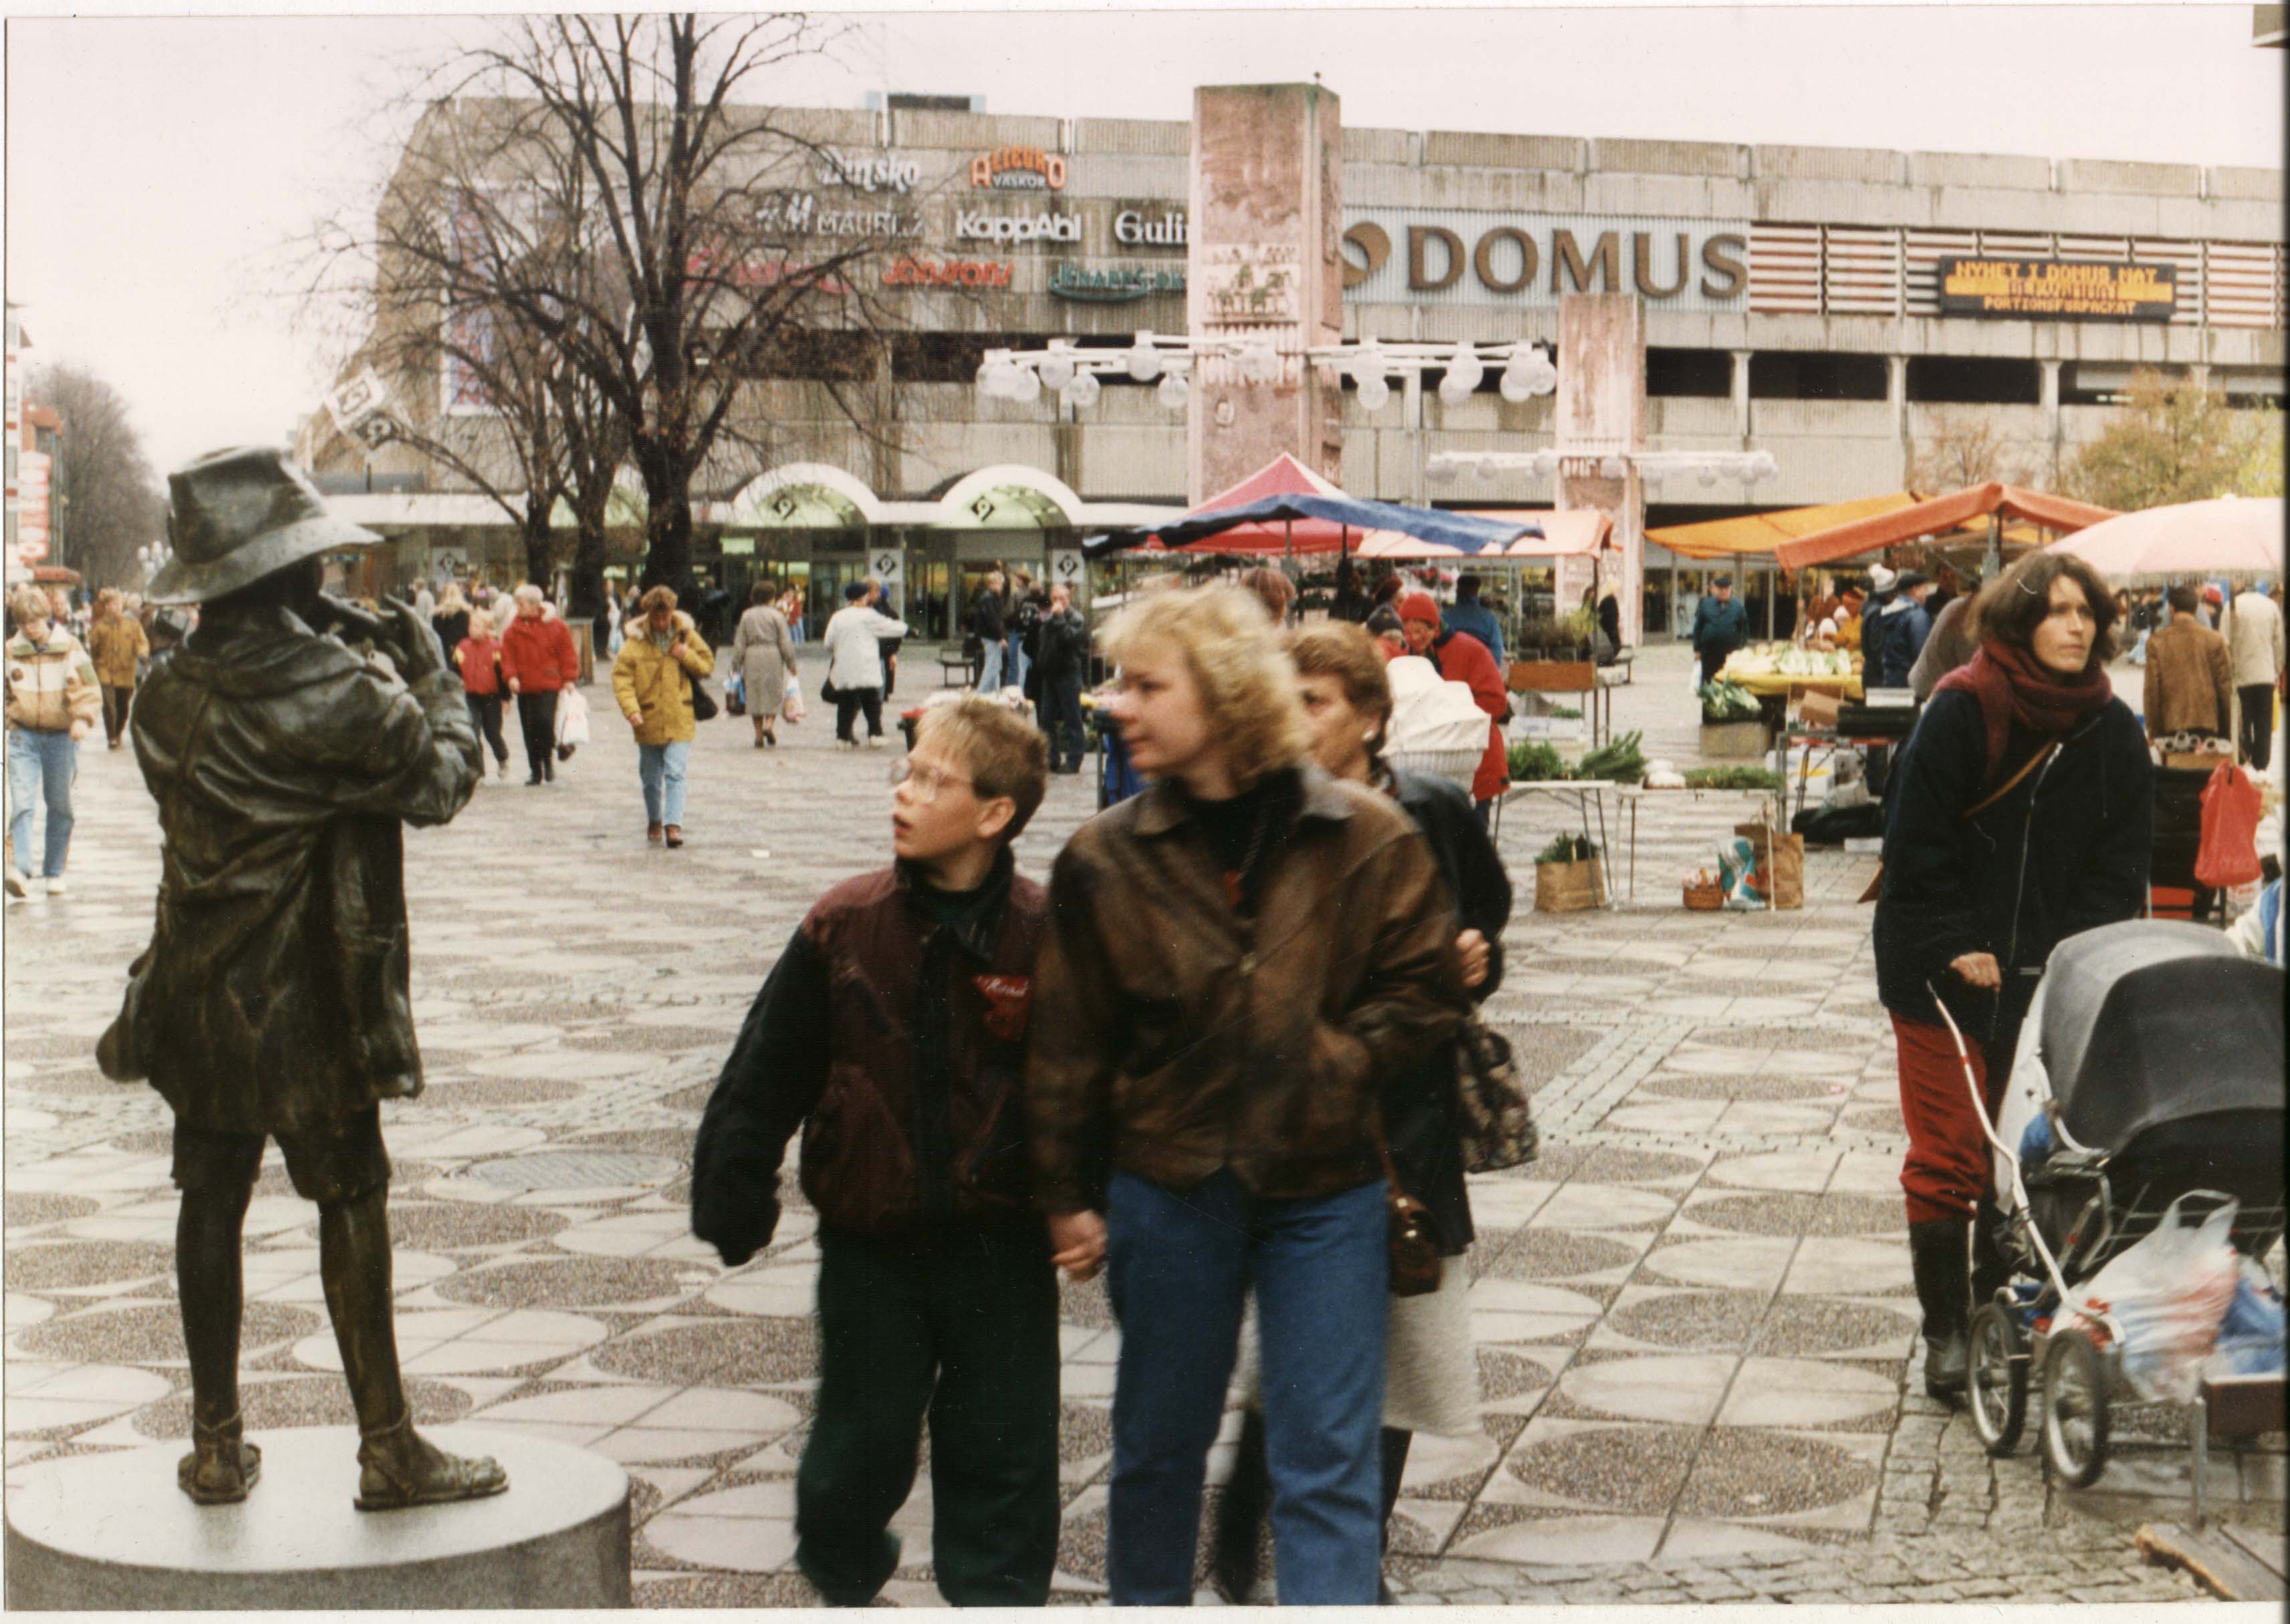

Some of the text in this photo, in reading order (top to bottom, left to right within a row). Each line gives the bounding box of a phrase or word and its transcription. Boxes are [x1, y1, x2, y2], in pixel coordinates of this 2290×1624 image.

[969, 144, 1068, 190] ALLEGRO
[956, 209, 1082, 245] KappAhl
[1115, 210, 1188, 243] Guli
[1407, 225, 1749, 300] DOMUS
[1955, 261, 2021, 281] NYHET
[2046, 263, 2111, 285] DOMUS
[2118, 266, 2158, 287] MAT
